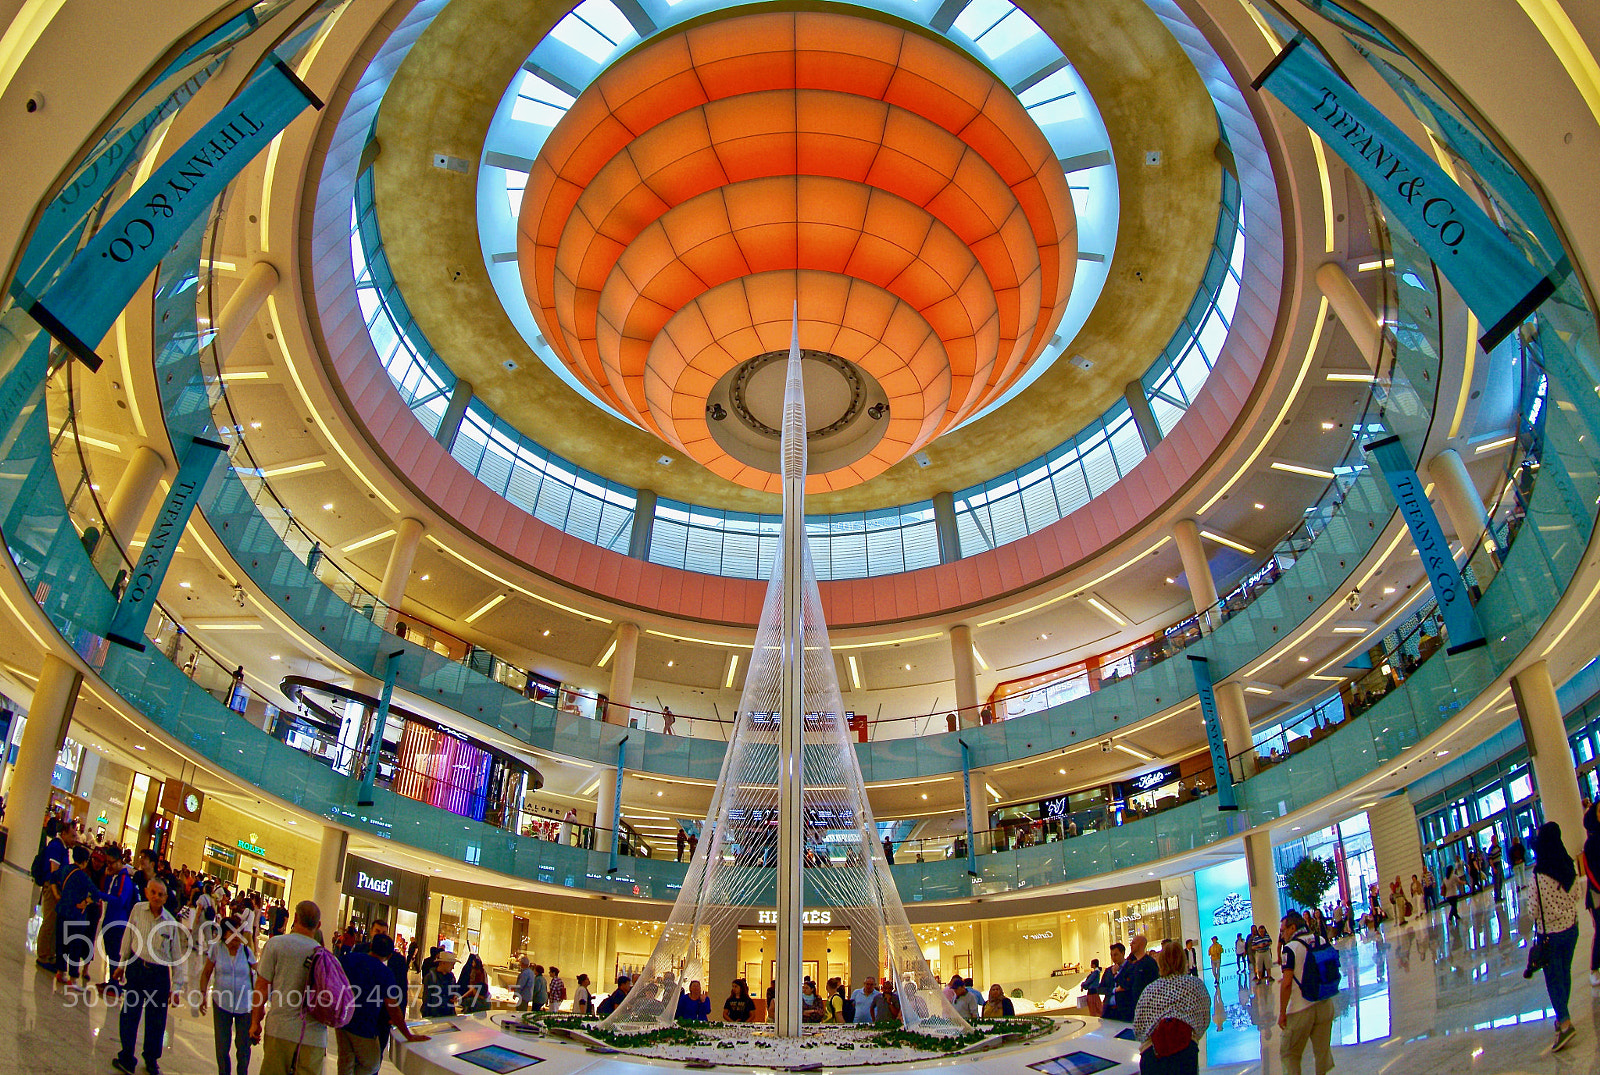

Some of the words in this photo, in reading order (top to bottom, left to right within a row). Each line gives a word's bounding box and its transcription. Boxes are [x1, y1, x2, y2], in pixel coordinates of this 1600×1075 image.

[167, 111, 264, 201] TIFFANY
[1311, 87, 1408, 182] TIFFANY
[1398, 177, 1425, 205] &
[1422, 197, 1465, 255] CO.
[145, 193, 174, 218] &
[101, 218, 155, 263] CO.
[151, 481, 196, 554] TIFFANY
[1397, 477, 1438, 552] TIFFANY
[1202, 686, 1219, 739] TIFFANY
[527, 803, 561, 815] ALONE
[237, 839, 266, 857] ROLEX
[357, 871, 394, 896] PIAGET
